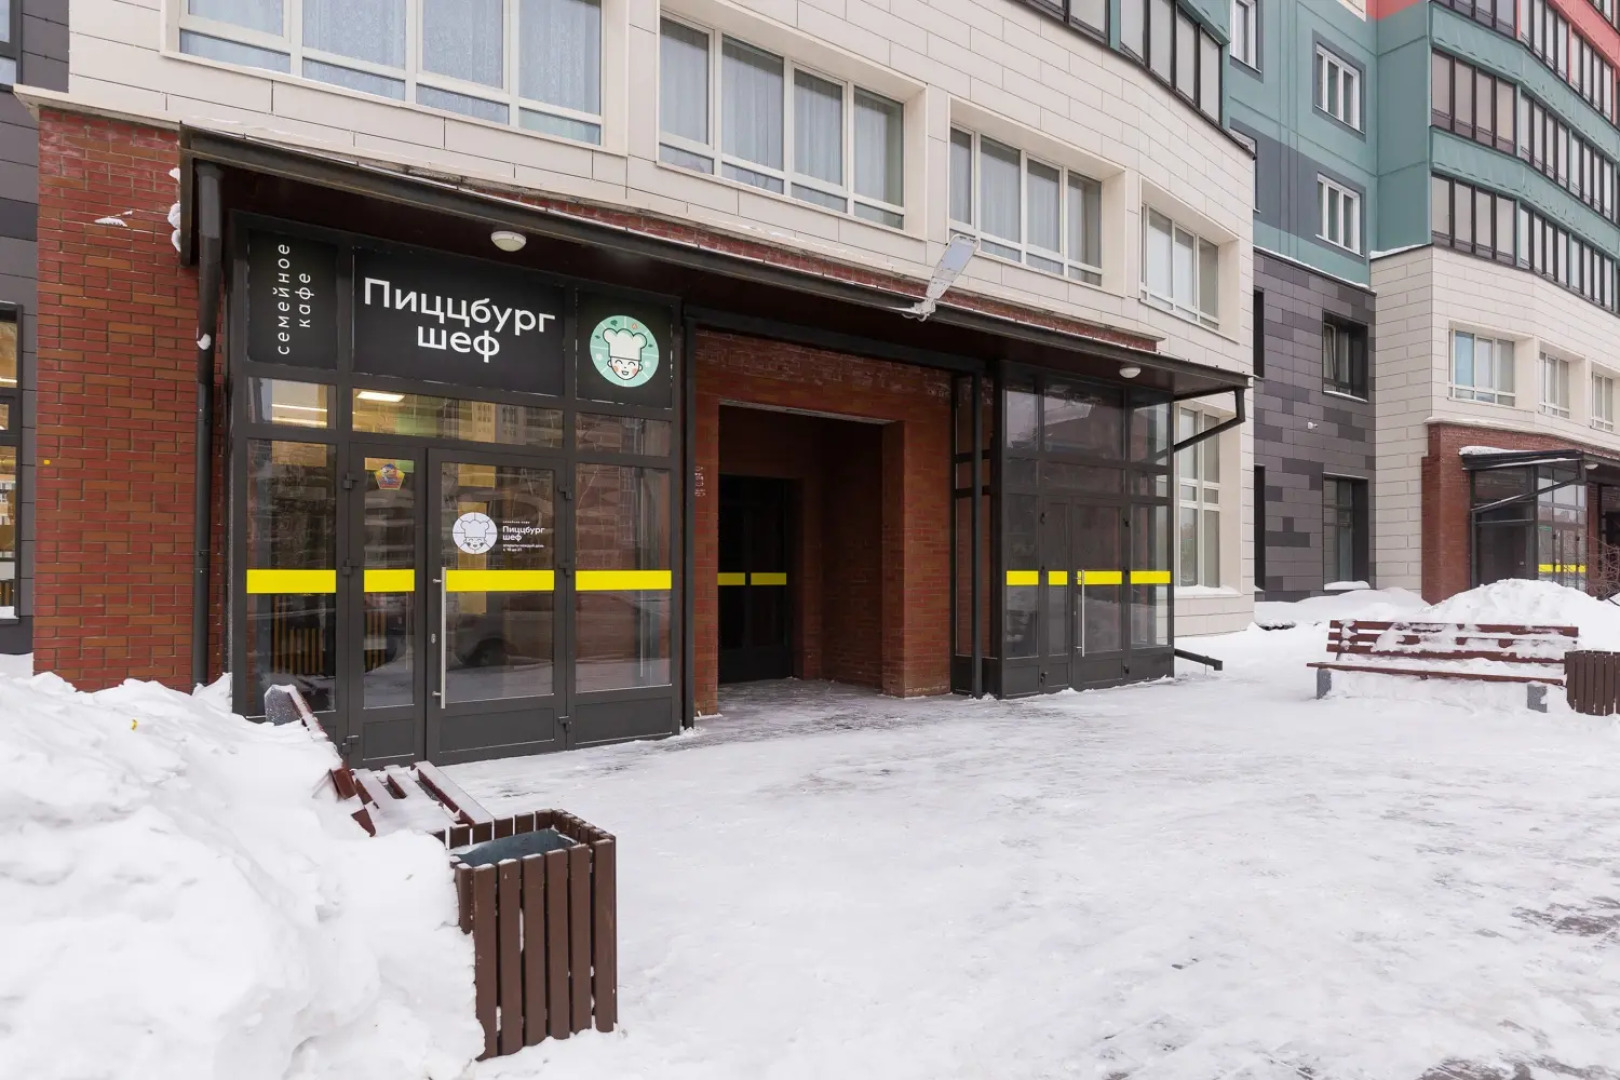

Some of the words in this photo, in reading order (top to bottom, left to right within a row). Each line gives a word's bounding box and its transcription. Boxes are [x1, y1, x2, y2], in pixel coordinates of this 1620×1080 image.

[272, 244, 290, 355] семейное
[294, 273, 315, 328] кафе
[364, 277, 556, 336] Пиццбург
[417, 325, 500, 363] шеф
[502, 525, 545, 535] Пиццбург
